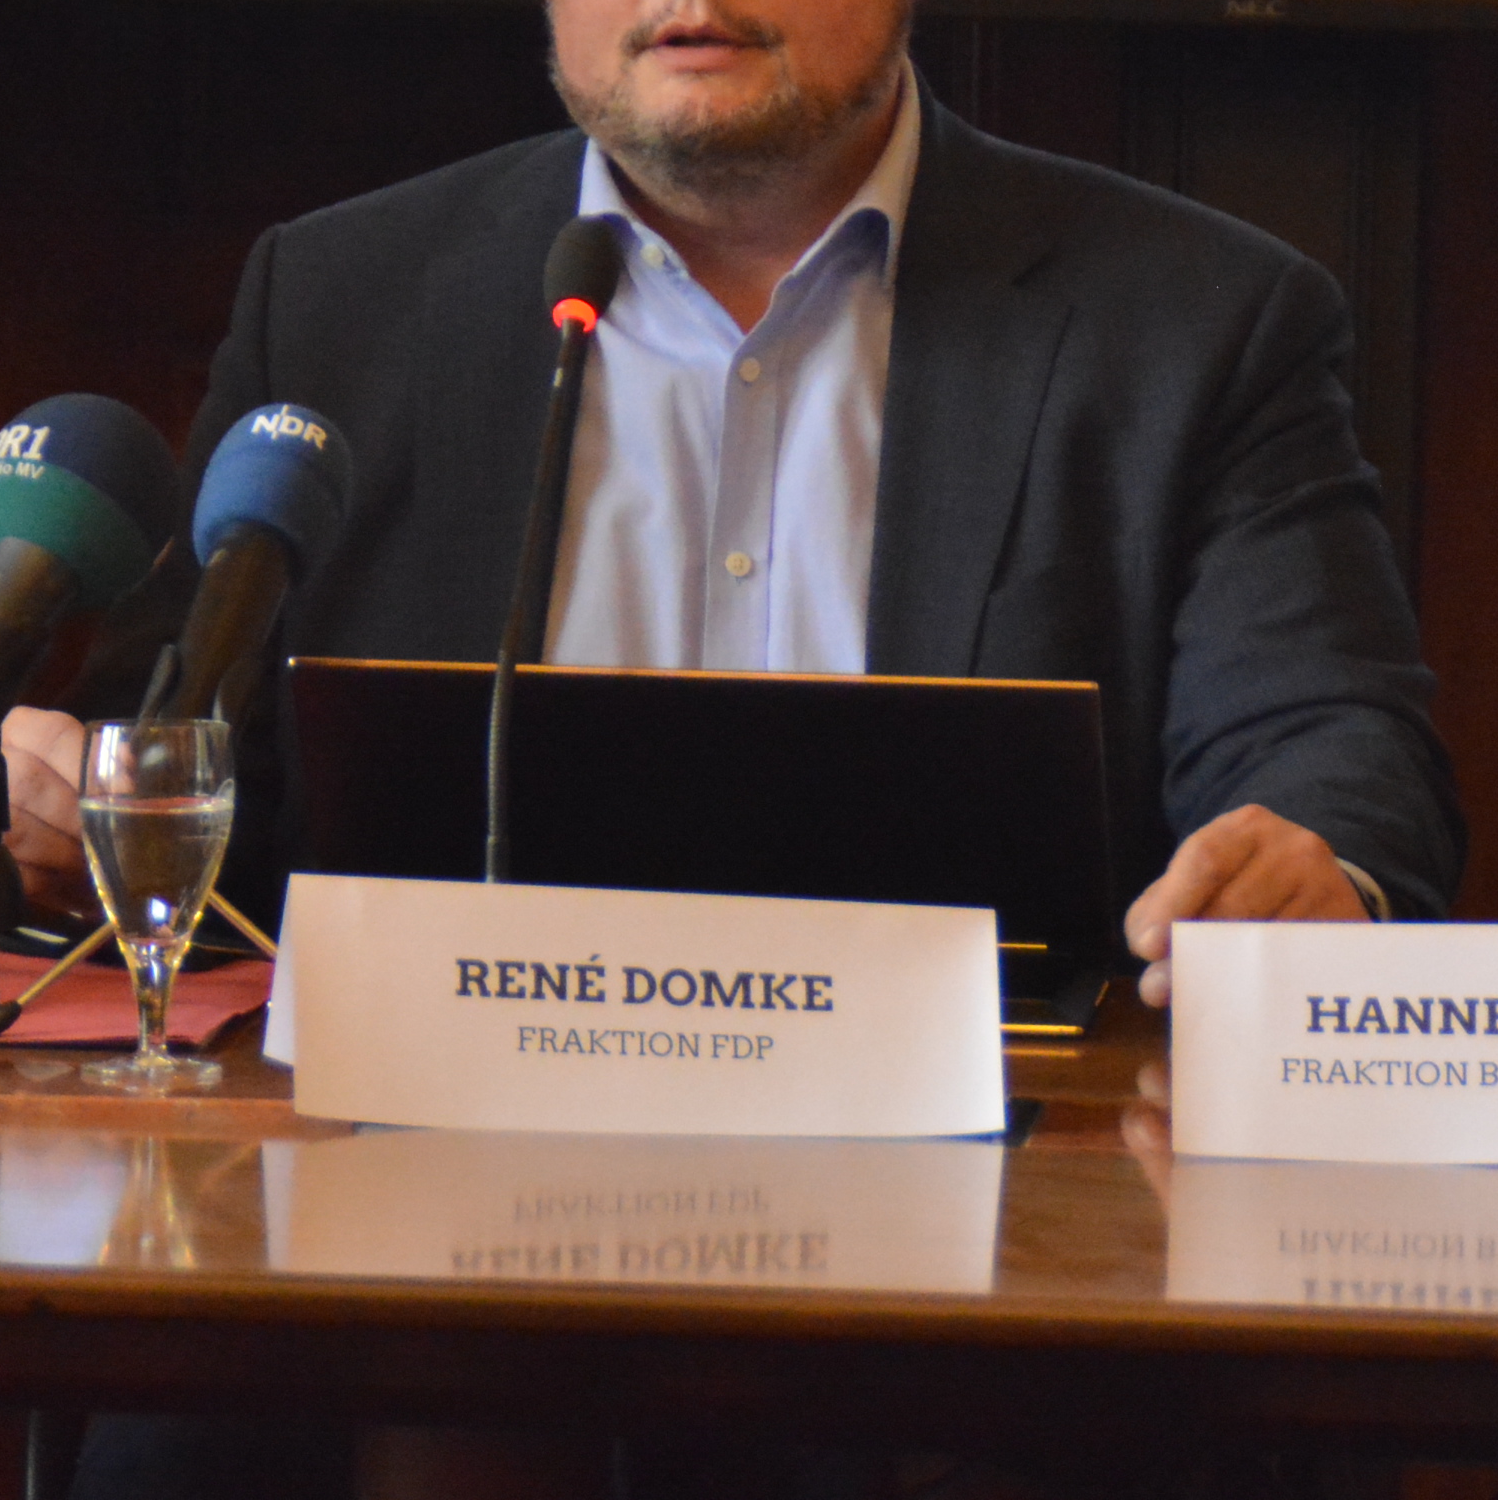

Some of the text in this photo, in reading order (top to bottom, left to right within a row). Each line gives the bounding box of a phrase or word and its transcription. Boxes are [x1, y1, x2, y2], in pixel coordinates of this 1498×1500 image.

[251, 404, 327, 450] NDR
[15, 461, 45, 479] MV
[456, 953, 834, 1012] RENÉ DOMKE
[517, 1026, 775, 1060] FRAKTION FDP
[1281, 1057, 1469, 1087] FRAKTION
